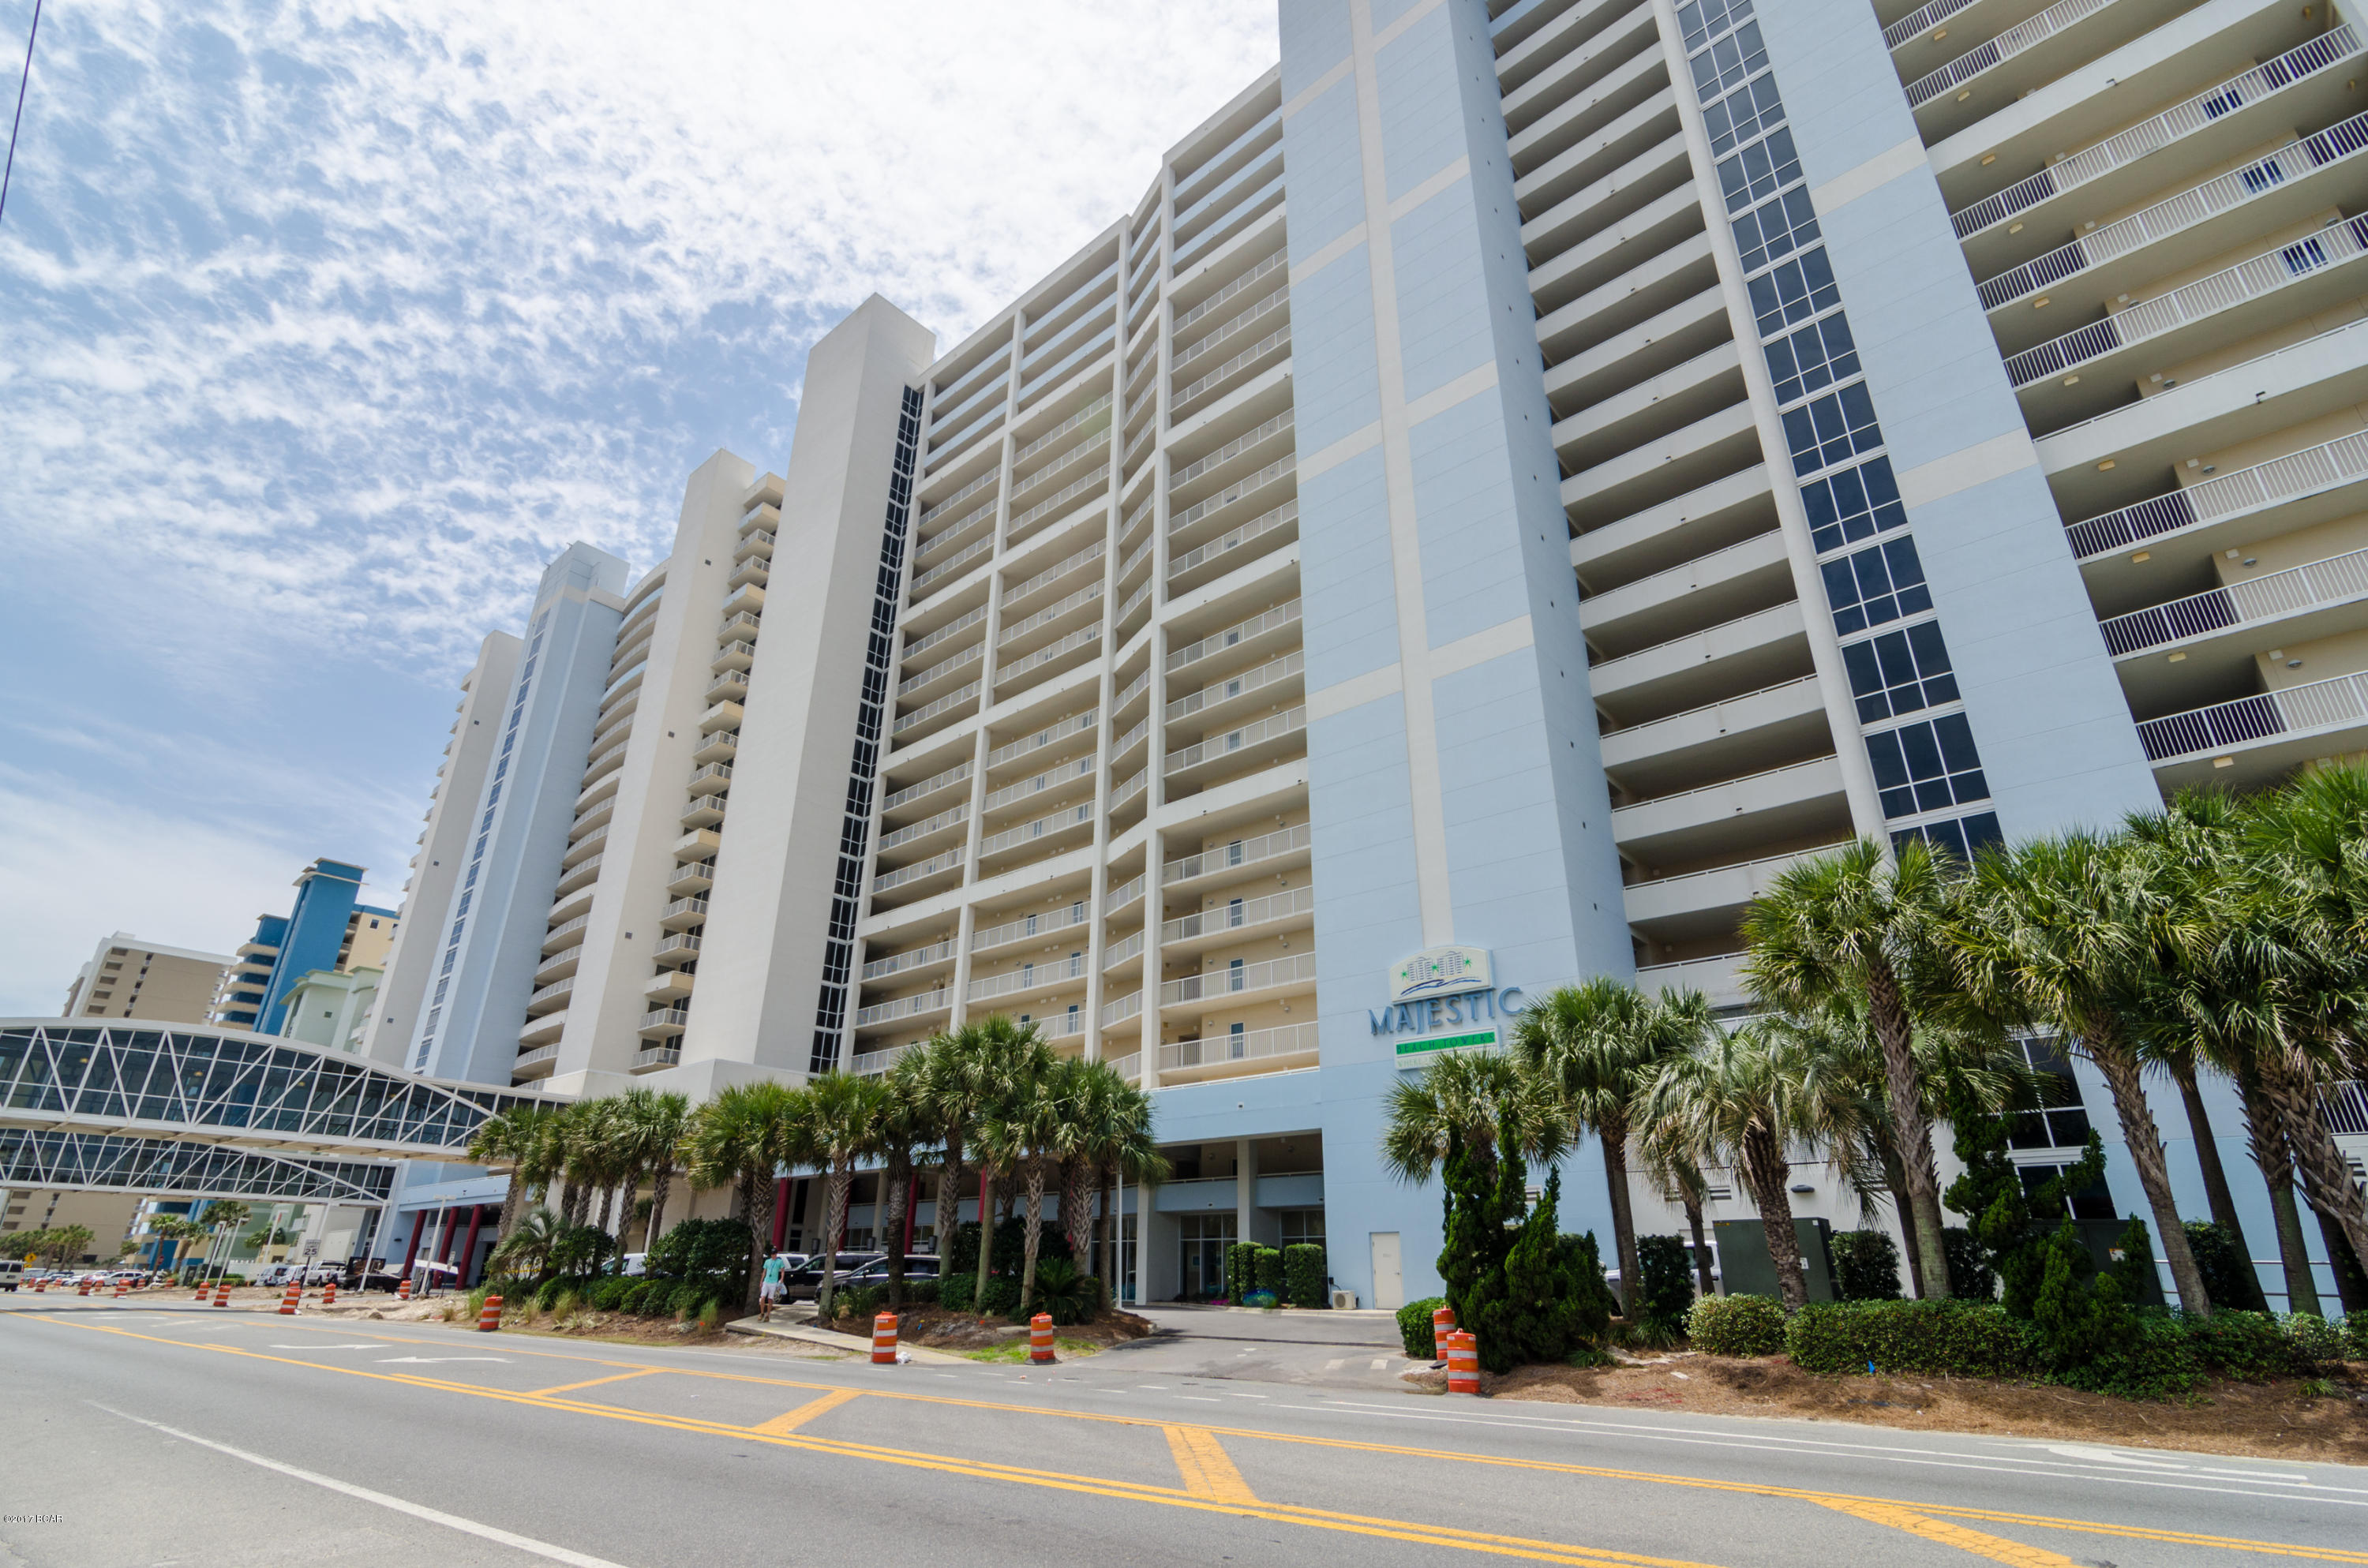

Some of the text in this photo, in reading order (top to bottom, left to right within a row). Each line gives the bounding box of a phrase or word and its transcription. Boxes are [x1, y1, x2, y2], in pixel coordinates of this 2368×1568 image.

[1368, 986, 1524, 1035] MAJESTIC
[1396, 1033, 1495, 1054] BEACH TOWERS
